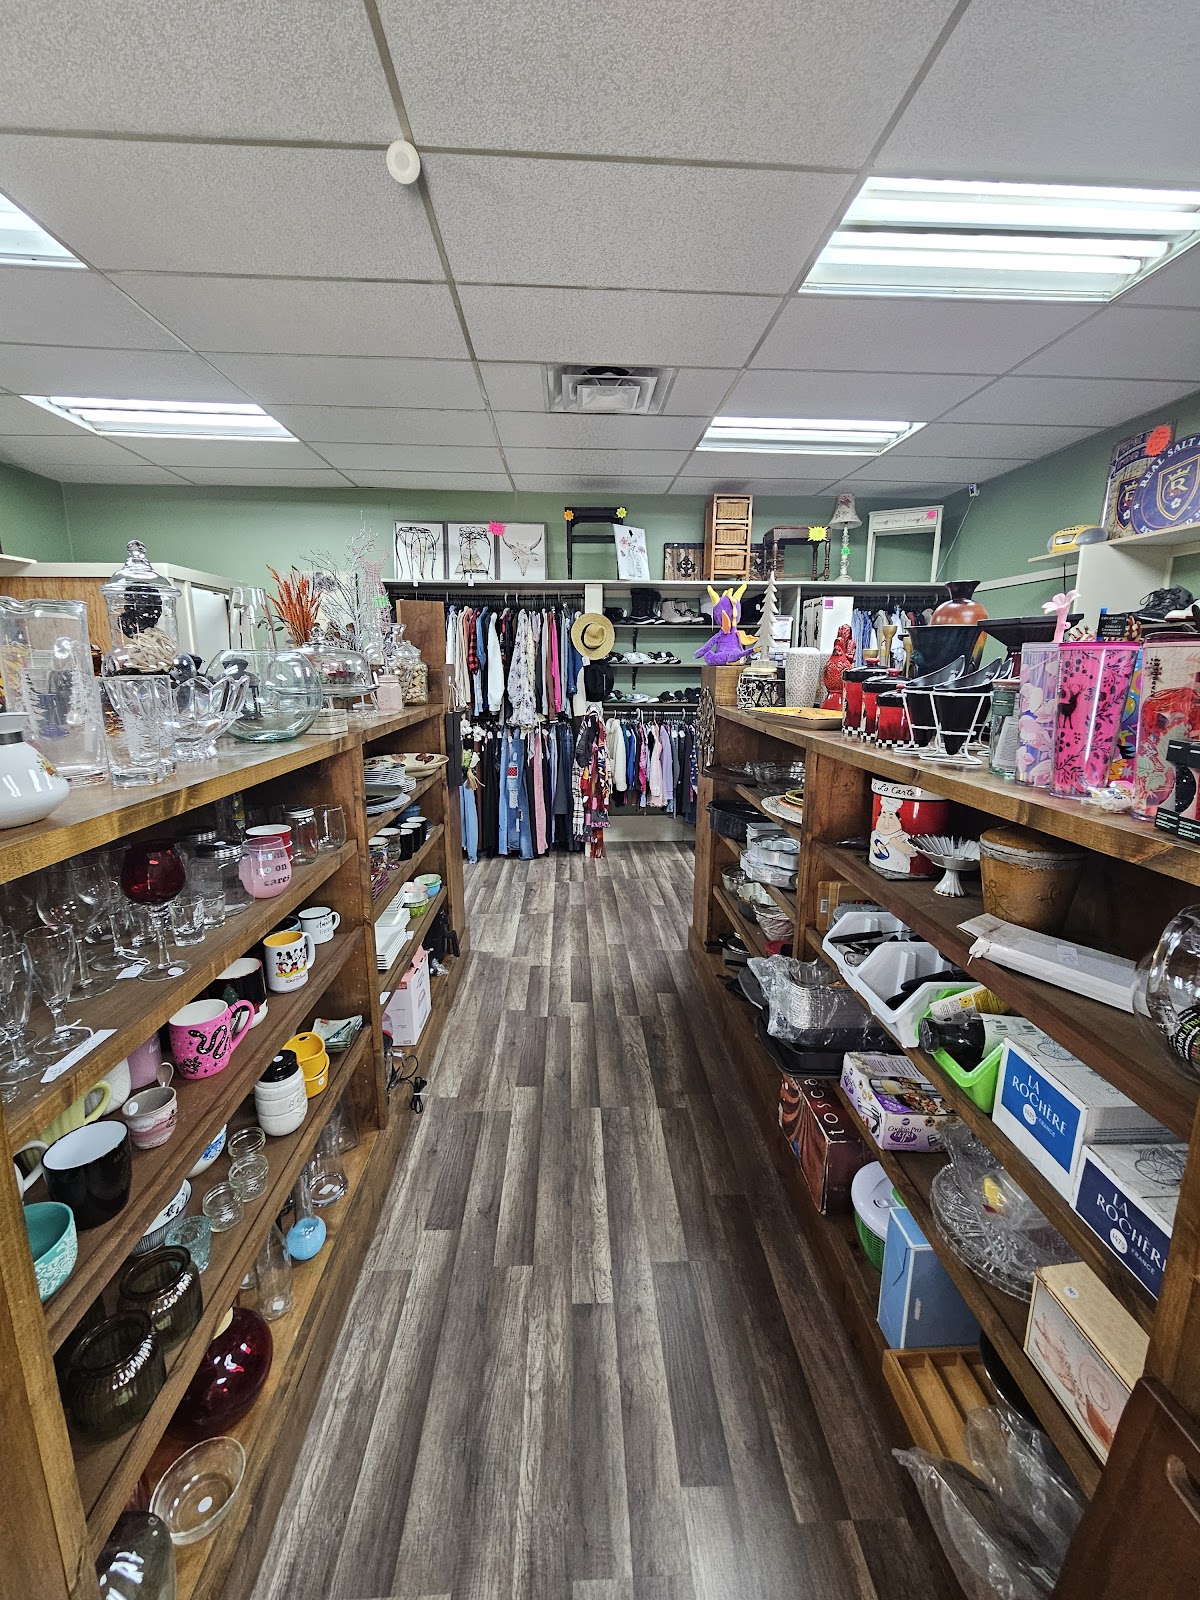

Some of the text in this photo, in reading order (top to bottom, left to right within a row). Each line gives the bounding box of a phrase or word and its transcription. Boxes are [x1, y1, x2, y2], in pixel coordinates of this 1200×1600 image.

[1140, 458, 1165, 488] REAL
[1167, 437, 1196, 457] SALT
[891, 786, 916, 797] Carte
[1028, 1074, 1040, 1095] LA
[804, 1078, 845, 1136] tosca
[1012, 1075, 1068, 1137] ROCHÈRE
[1038, 1117, 1057, 1138] FRANCE
[1113, 1193, 1129, 1218] LA
[1130, 1248, 1156, 1275] FRANCE
